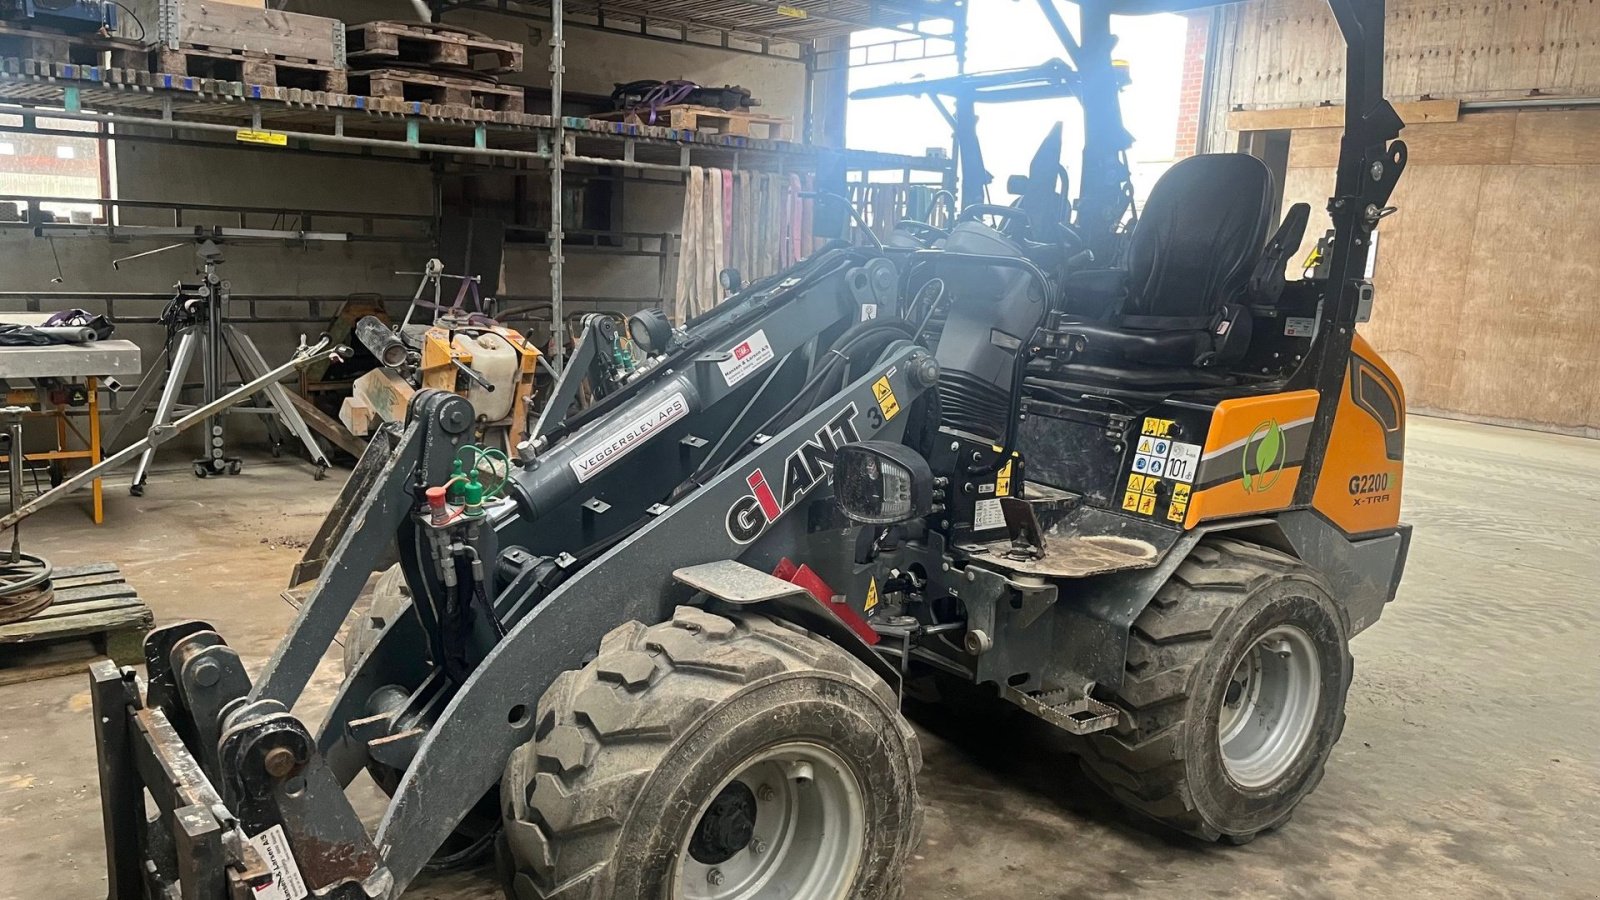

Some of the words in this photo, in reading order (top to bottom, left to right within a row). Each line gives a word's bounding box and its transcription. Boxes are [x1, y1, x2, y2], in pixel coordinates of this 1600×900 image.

[867, 406, 883, 430] 3
[579, 419, 654, 471] VEGGERSLEV
[659, 401, 682, 420] APS
[1169, 458, 1187, 479] 101
[1353, 494, 1390, 506] X-TRA
